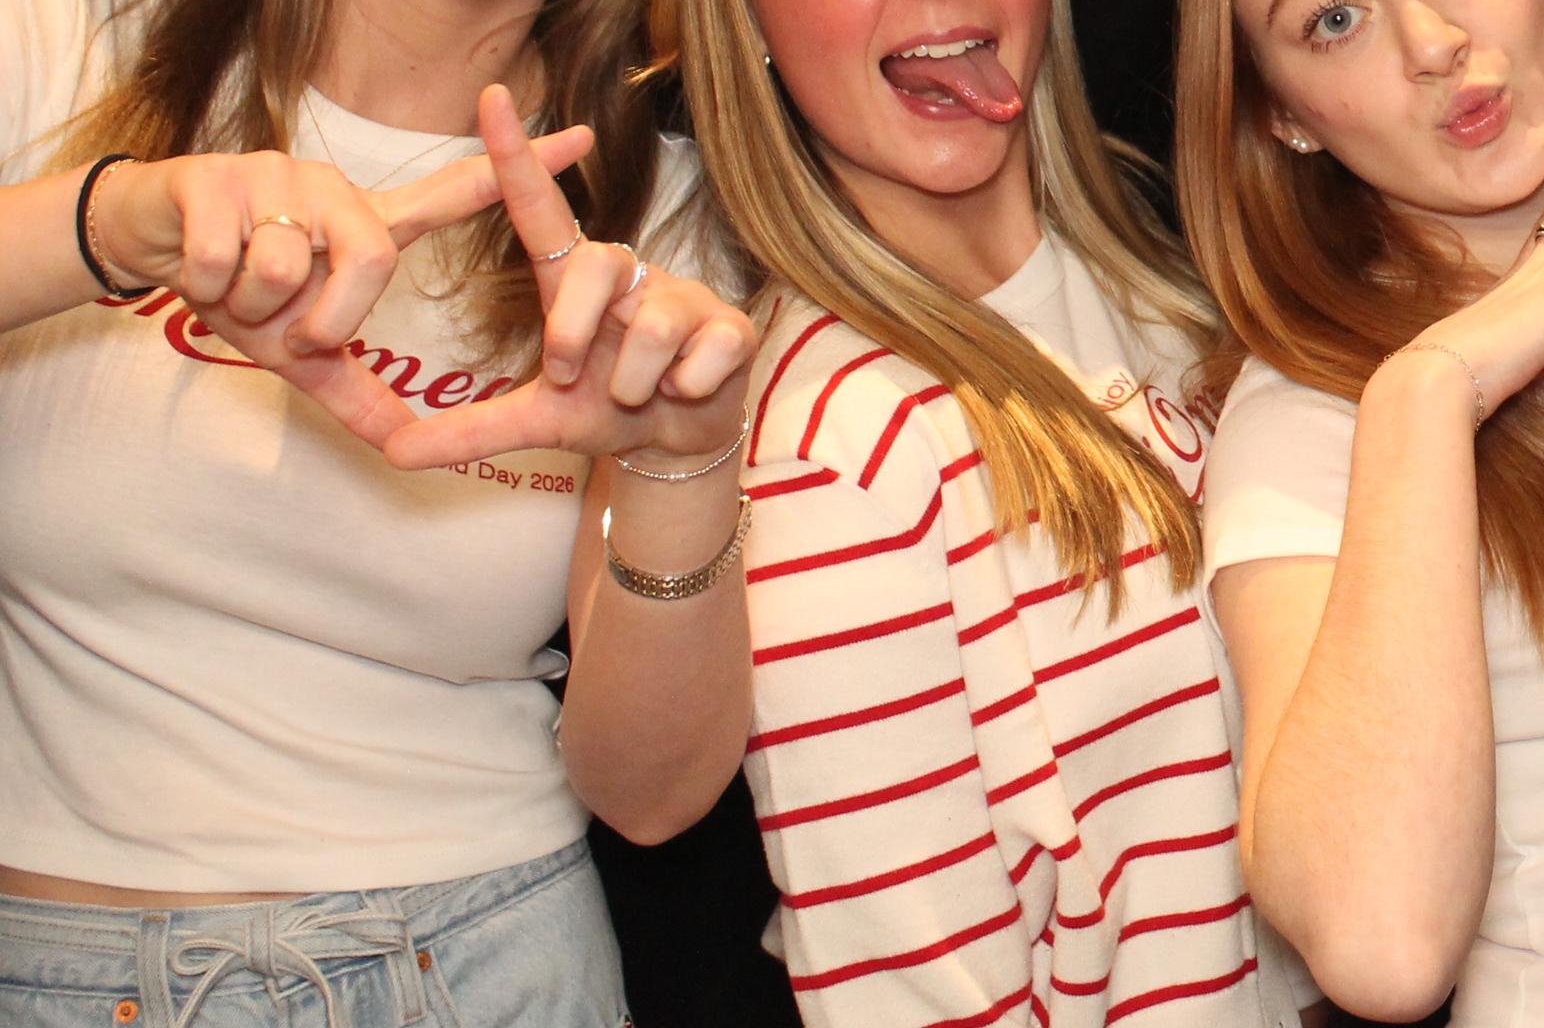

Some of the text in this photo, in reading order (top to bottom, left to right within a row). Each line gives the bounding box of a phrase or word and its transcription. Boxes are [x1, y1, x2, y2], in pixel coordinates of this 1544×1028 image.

[1096, 371, 1135, 410] joy
[478, 461, 523, 489] Day
[530, 472, 575, 493] 2026
